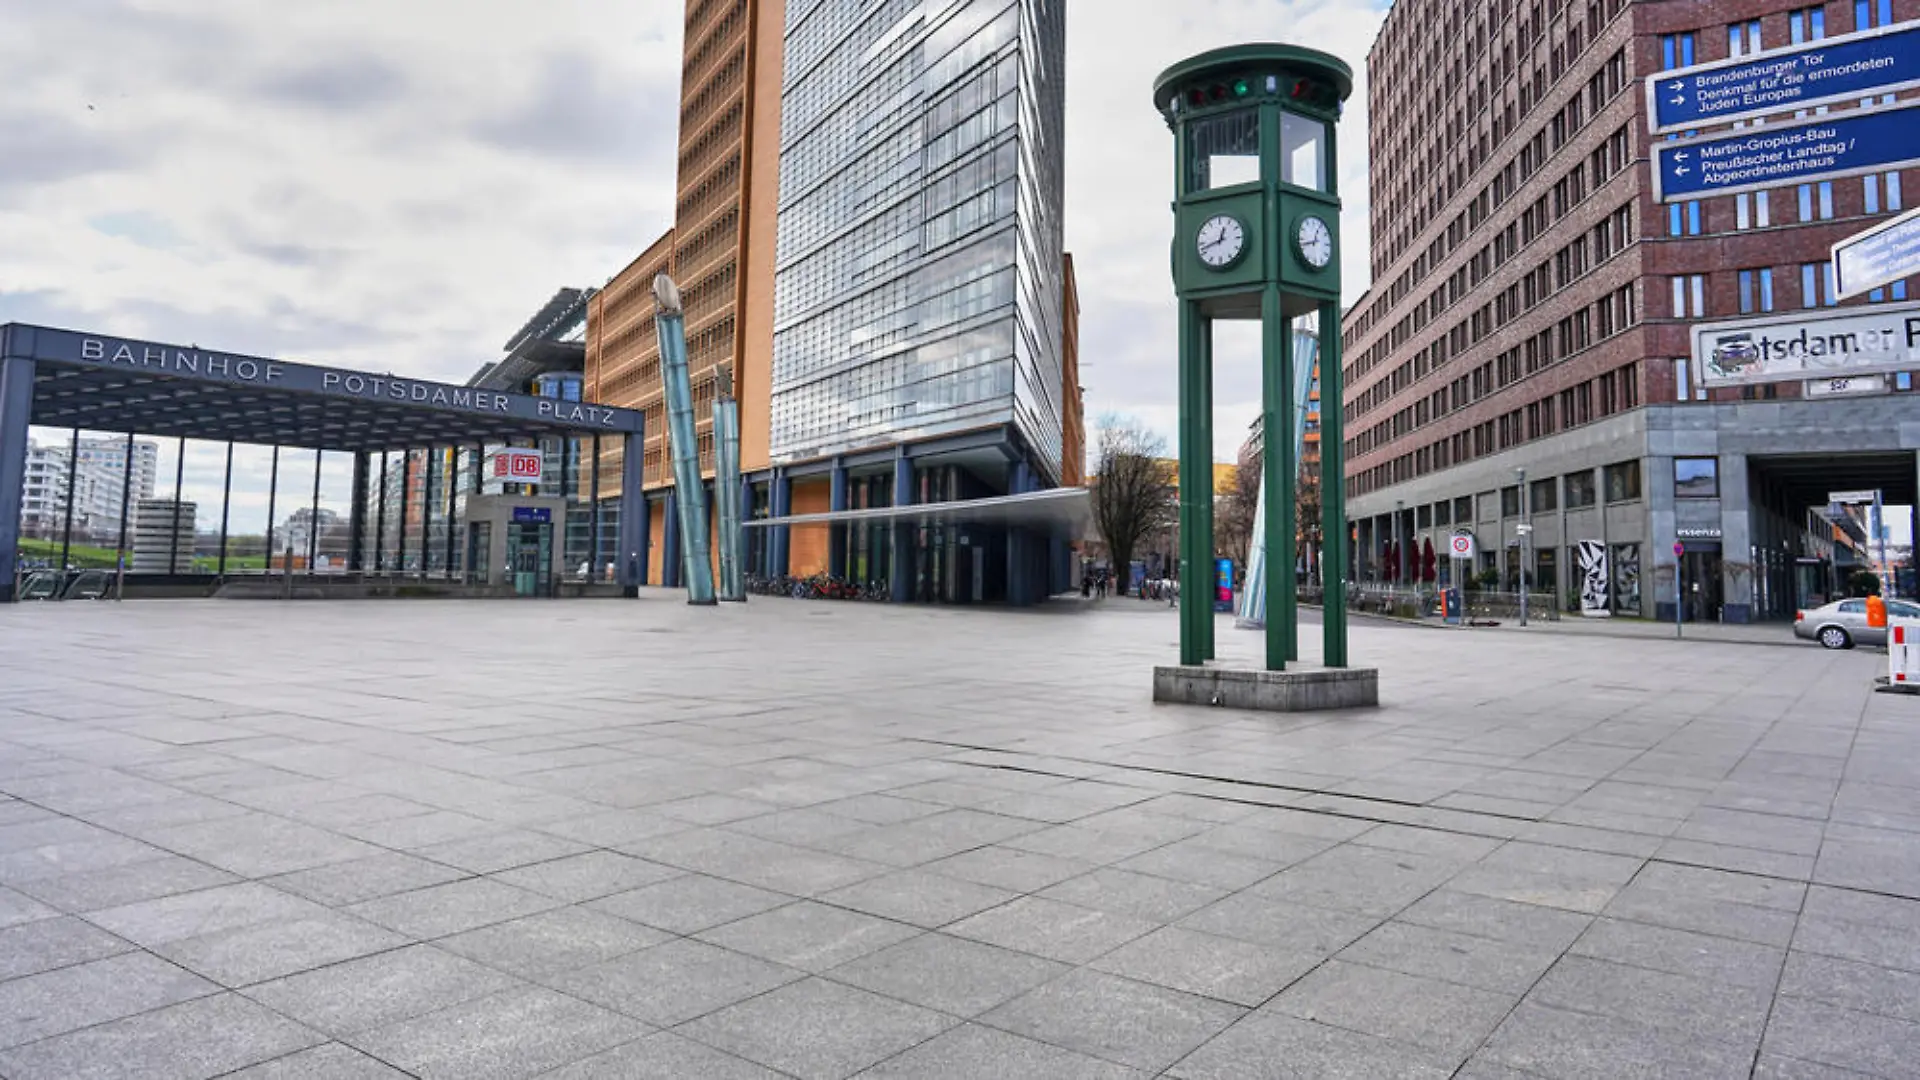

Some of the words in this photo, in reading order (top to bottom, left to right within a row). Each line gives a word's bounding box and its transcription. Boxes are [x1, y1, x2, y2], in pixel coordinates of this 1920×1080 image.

[1696, 61, 1799, 87] Brandenburger
[1801, 54, 1825, 67] Tor
[1697, 81, 1758, 101] Denkmal
[1759, 77, 1779, 90] für
[1783, 73, 1804, 86] die
[1808, 56, 1894, 81] ermordeten
[1698, 97, 1741, 113] Juden
[1742, 86, 1801, 105] Europas
[1700, 128, 1837, 159] Martin-Gropius-Bau
[1702, 150, 1784, 173] Preußischer
[1786, 140, 1846, 160] Landtag
[1703, 155, 1835, 185] Abgeordnetenhaus
[81, 338, 286, 382] BAHNHOF
[322, 371, 510, 413] POTSDAMER
[537, 400, 616, 426] PLATZ
[515, 457, 537, 474] DB
